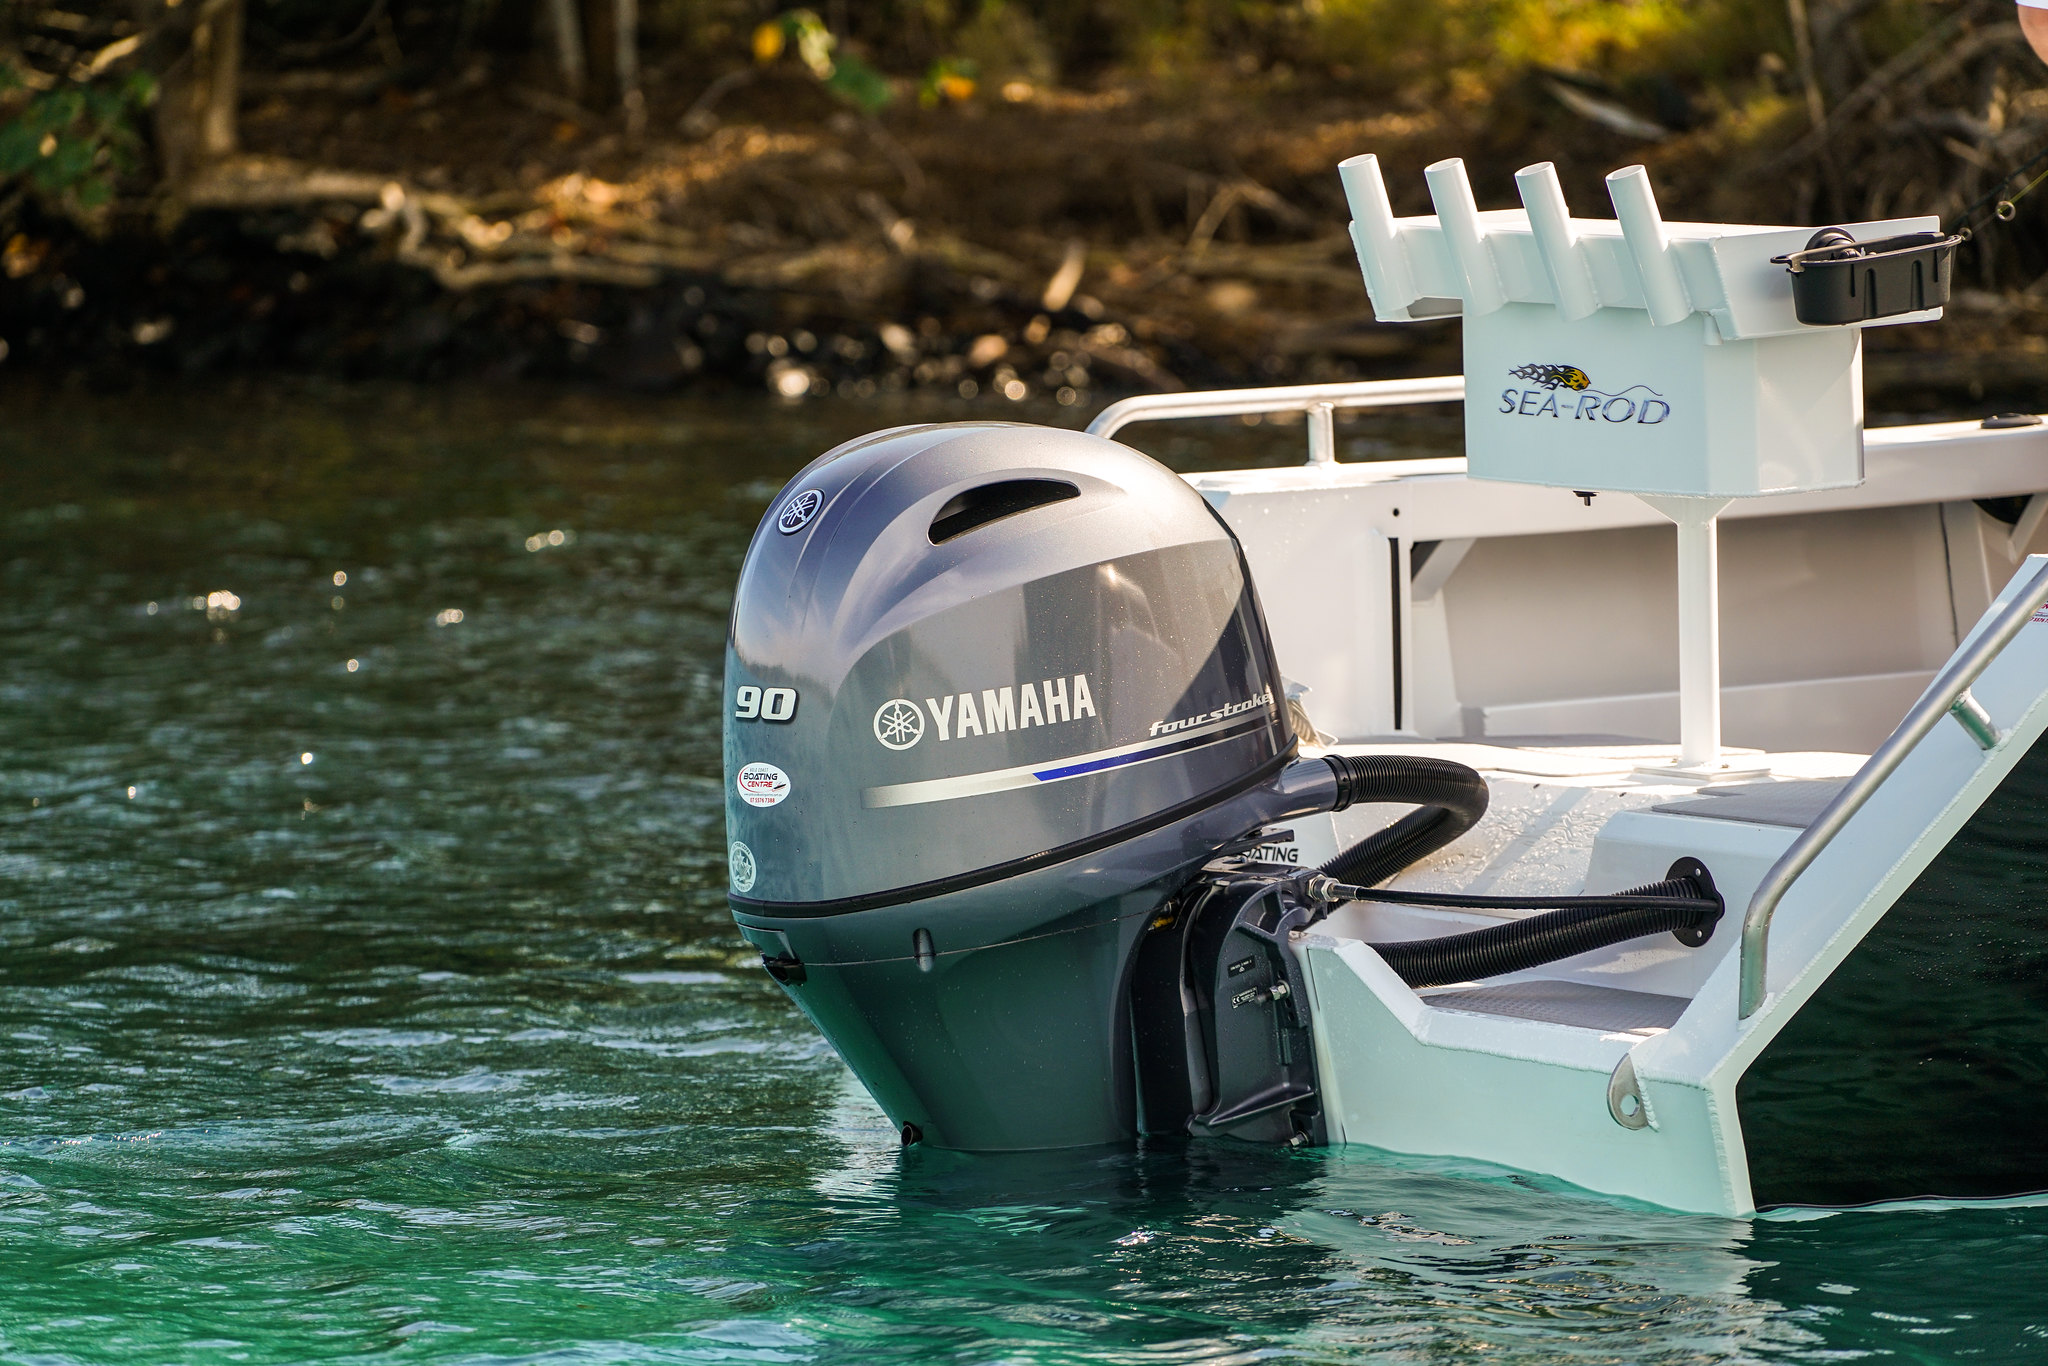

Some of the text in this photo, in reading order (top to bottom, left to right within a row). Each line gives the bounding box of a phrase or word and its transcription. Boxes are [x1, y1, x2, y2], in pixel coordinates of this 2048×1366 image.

[1498, 388, 1671, 425] SEA-ROD
[735, 685, 797, 720] 90
[926, 673, 1097, 741] YAMAHA
[1149, 693, 1271, 737] four stroke
[744, 772, 778, 781] BOATING
[1248, 846, 1299, 863] ATING
